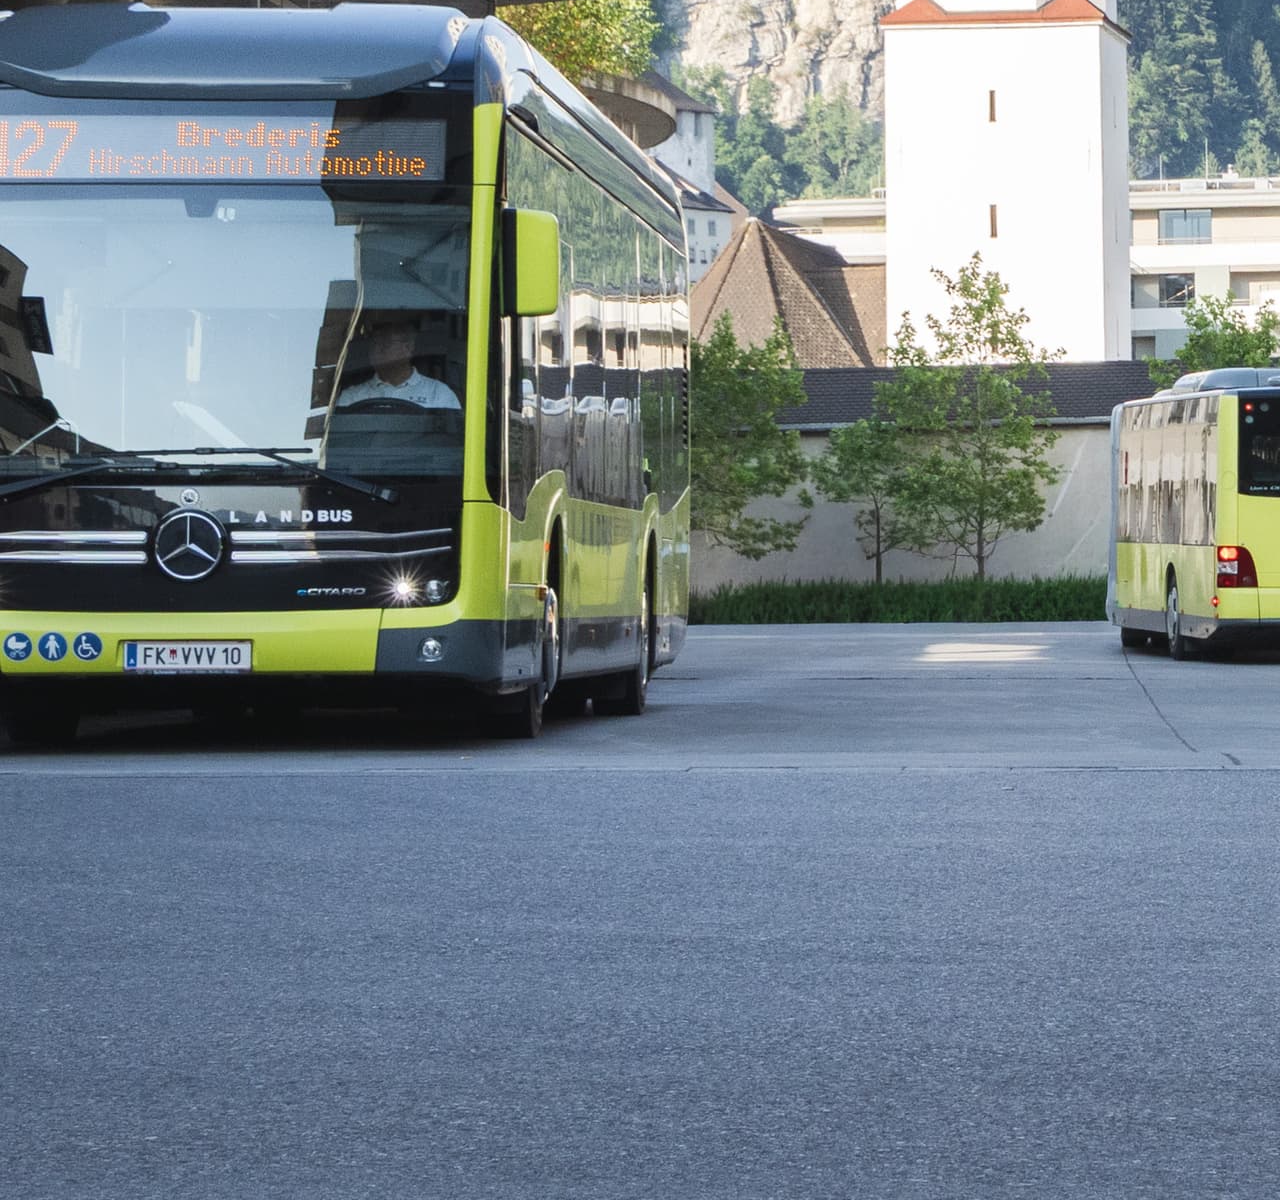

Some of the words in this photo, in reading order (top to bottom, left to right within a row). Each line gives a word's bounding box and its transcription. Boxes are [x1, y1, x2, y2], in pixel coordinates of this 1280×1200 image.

[177, 121, 340, 148] Brederis
[89, 149, 253, 175] Hirschmann
[266, 150, 427, 176] Automotive
[229, 509, 352, 523] LANDBUS
[297, 588, 366, 596] eCITARO
[143, 647, 166, 664] FK
[181, 647, 216, 664] VVV
[222, 646, 241, 665] 10
